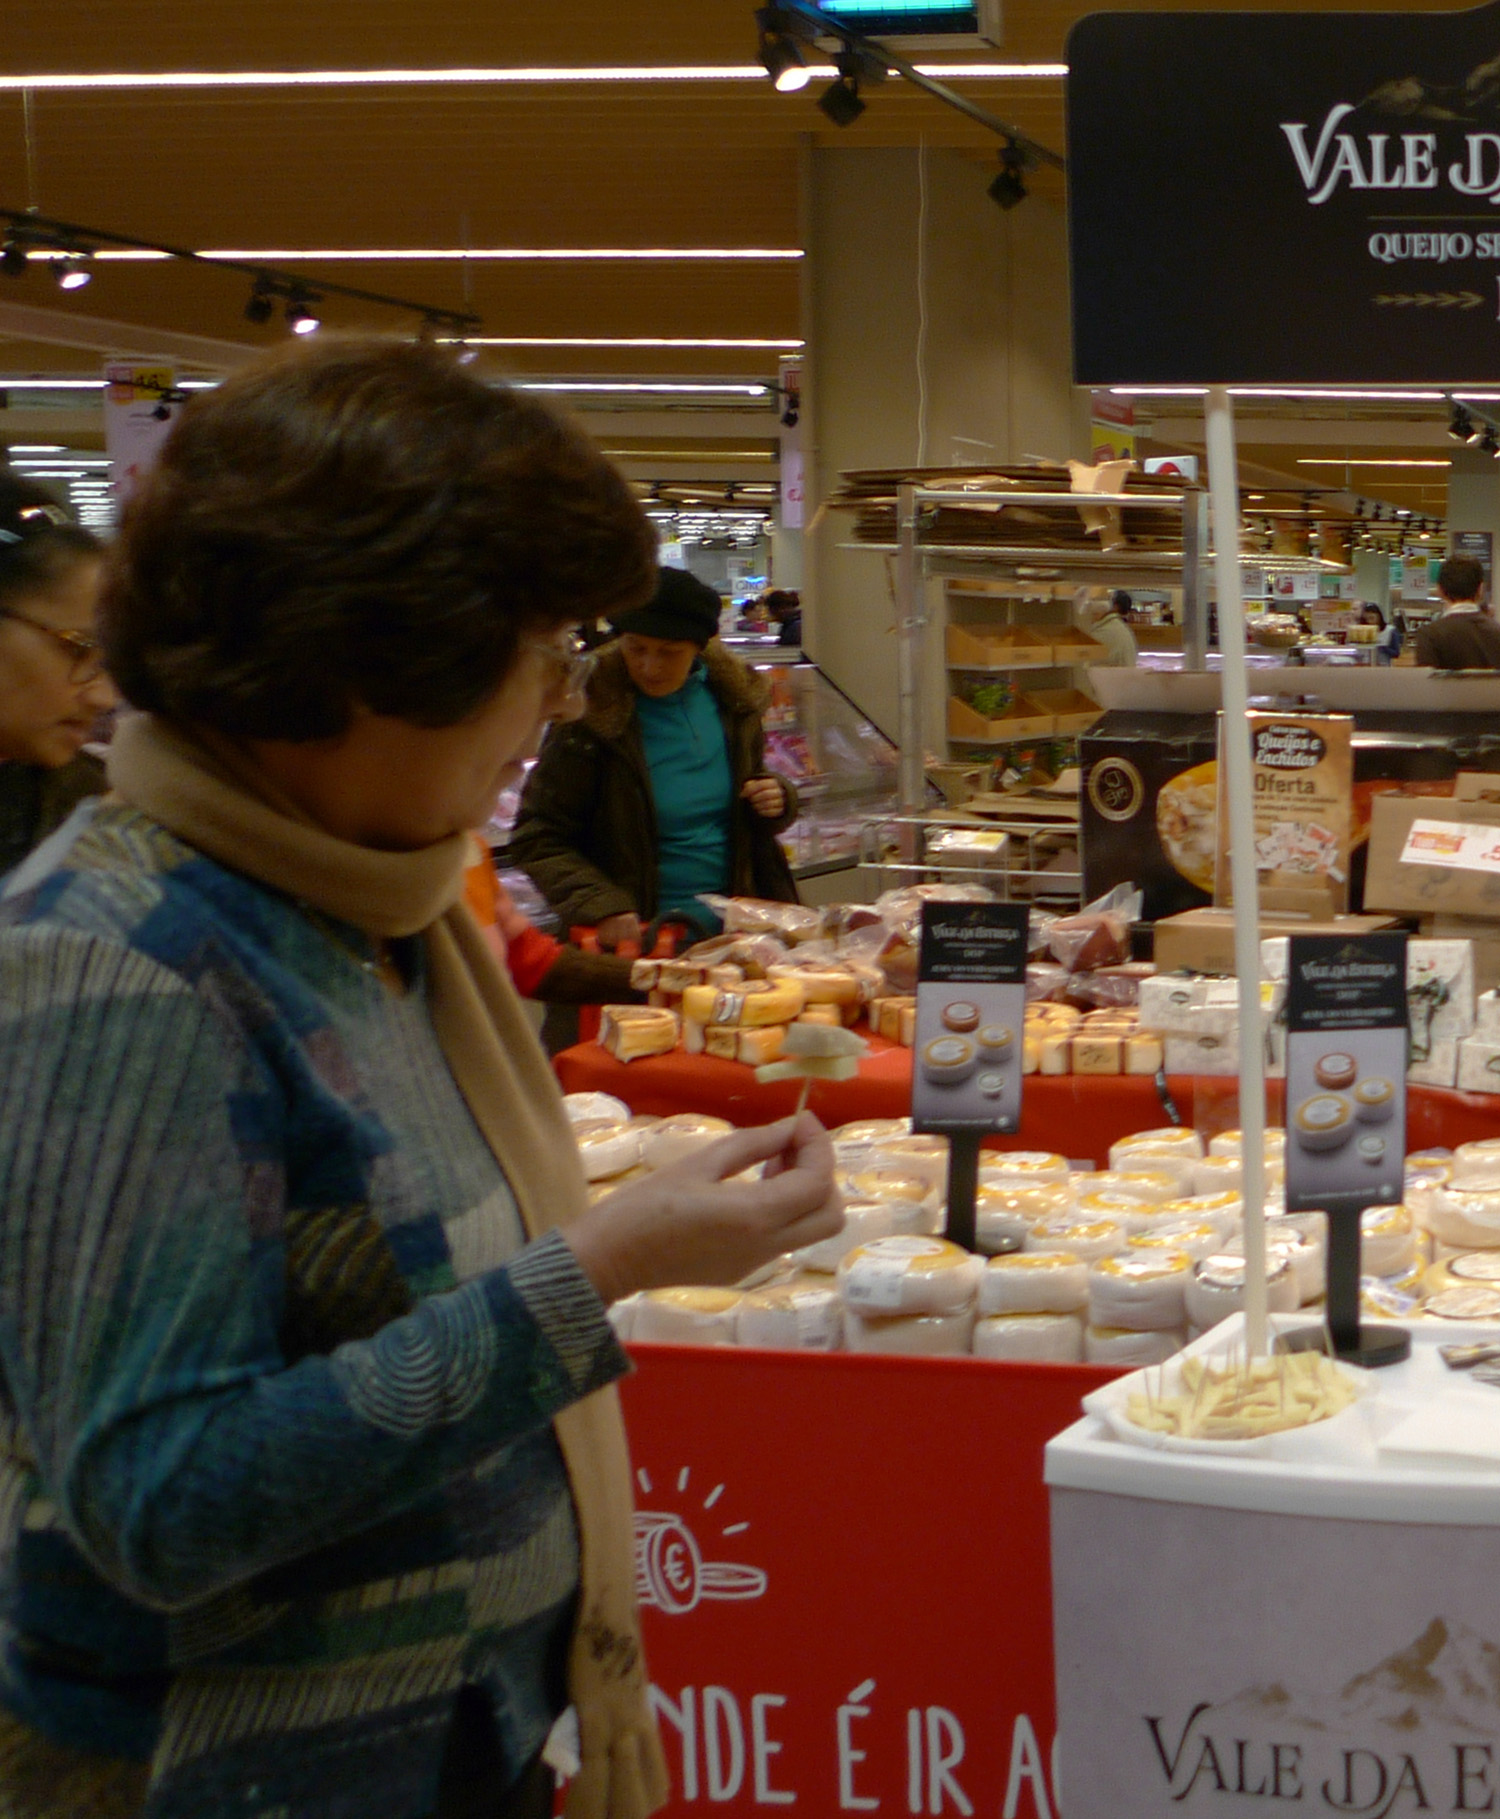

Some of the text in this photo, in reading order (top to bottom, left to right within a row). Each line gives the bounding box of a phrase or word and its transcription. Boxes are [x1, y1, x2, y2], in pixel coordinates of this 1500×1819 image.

[1279, 103, 1439, 204] VALE
[1368, 232, 1474, 263] QUEIJO
[1254, 773, 1316, 794] Oferta
[836, 1677, 881, 1811] É
[907, 1705, 974, 1816] IR
[1002, 1712, 1061, 1819] A
[1143, 1702, 1304, 1801] VALE
[1321, 1747, 1432, 1819] DA
